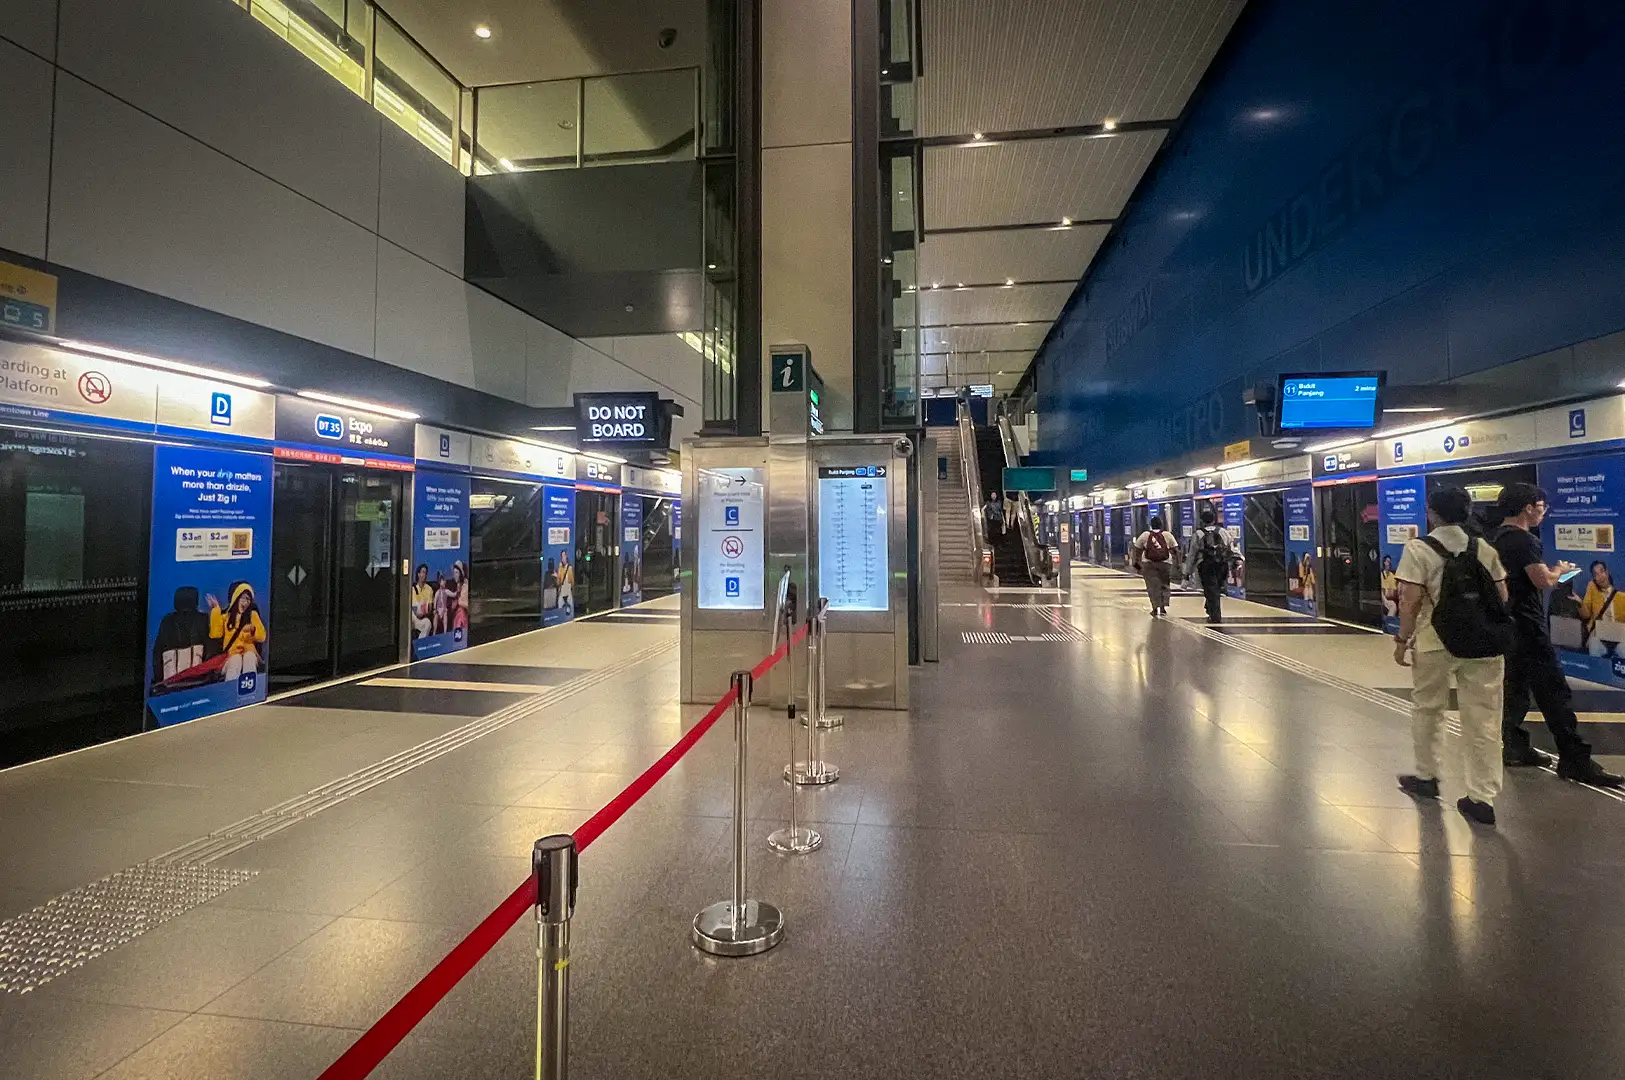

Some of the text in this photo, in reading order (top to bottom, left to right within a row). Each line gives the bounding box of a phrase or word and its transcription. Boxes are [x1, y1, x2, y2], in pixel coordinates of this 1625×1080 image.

[53, 368, 67, 380] at
[1286, 386, 1296, 394] 11
[216, 397, 228, 415] D
[33, 409, 49, 418] Line
[589, 406, 646, 420] DO NOT
[318, 421, 340, 434] DT 35
[349, 417, 373, 434] Expo
[1572, 414, 1582, 429] C
[592, 423, 645, 437] BOARD
[170, 466, 262, 482] When your drip matters
[182, 481, 205, 489] more
[206, 480, 224, 490] than
[198, 493, 215, 502] Just
[217, 494, 230, 505] Zig
[728, 509, 737, 520] C
[182, 532, 194, 541] $3
[210, 532, 221, 541] $2
[728, 580, 737, 591] D
[241, 676, 254, 689] zig
